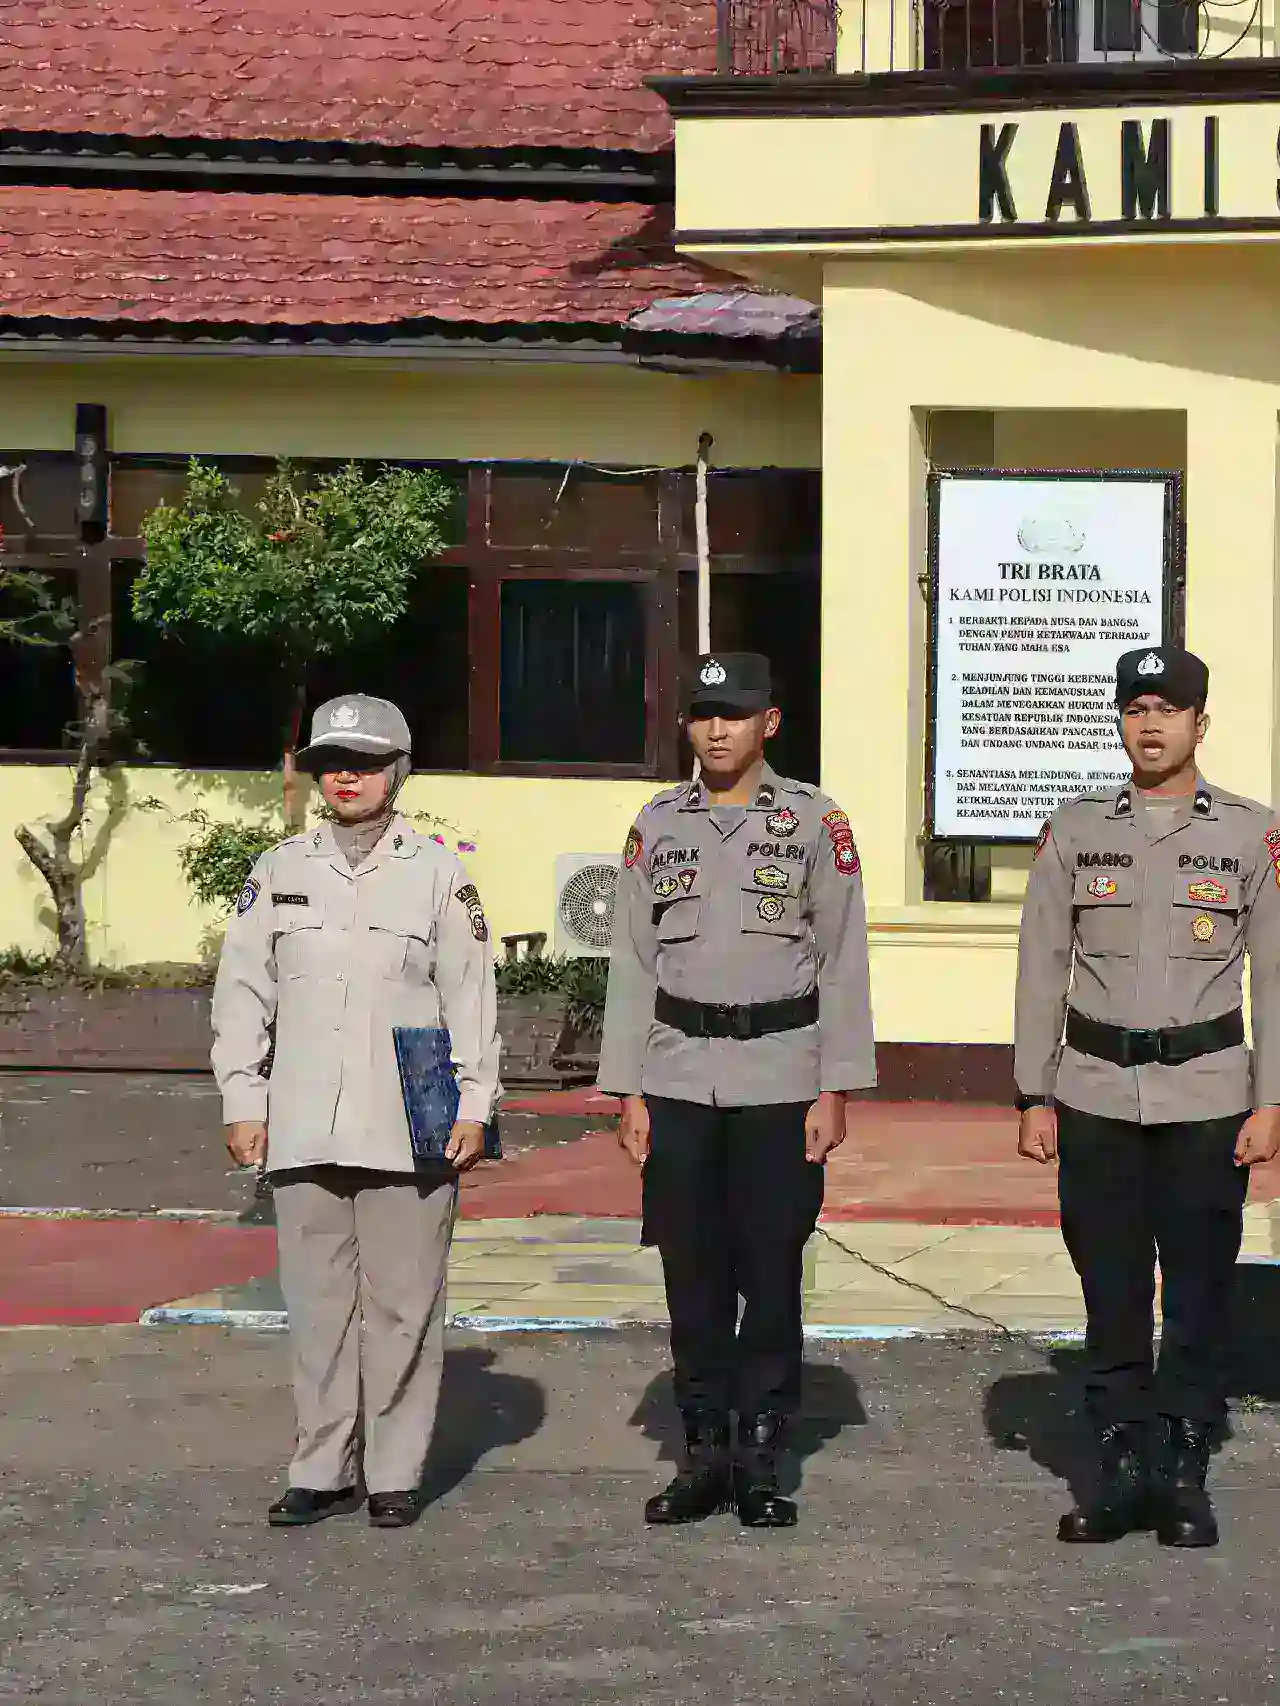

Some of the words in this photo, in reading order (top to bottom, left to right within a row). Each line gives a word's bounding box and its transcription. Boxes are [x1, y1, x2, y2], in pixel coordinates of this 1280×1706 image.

[978, 115, 1219, 224] KAMI
[998, 562, 1031, 580] TRI
[1037, 563, 1102, 582] BRATA
[949, 587, 994, 602] KAMI
[999, 588, 1052, 603] POLISI
[1056, 589, 1152, 604] INDONESIA
[959, 617, 1007, 626] BERBAKTI
[1010, 617, 1048, 626] KEPADA
[1050, 617, 1076, 627] NUSA
[1078, 617, 1098, 627] DAN
[1100, 618, 1139, 628] BANGSA
[958, 629, 998, 639] DENGAN
[1001, 629, 1034, 640] PENUH
[1036, 630, 1096, 641] KETAKWAAN
[958, 642, 991, 652] TUHAN
[994, 643, 1018, 653] YANG
[1021, 643, 1048, 653] MAHA
[1051, 643, 1071, 653] ESA
[961, 673, 1029, 684] MENJUNJUNG
[1031, 673, 1065, 684] TINGGI
[961, 686, 1010, 696] KEADILAN
[1012, 686, 1032, 696] DAN
[1034, 687, 1106, 697] KEMANUSIAAN
[961, 699, 994, 709] DALAM
[996, 699, 1066, 710] MENEGAKKAN
[1067, 700, 1104, 710] HUKUM
[961, 712, 1012, 723] KESATUAN
[1013, 713, 1064, 723] REPUBLIK
[1065, 713, 1119, 724] INDONESIA
[960, 726, 987, 736] YANG
[988, 726, 1060, 737] BERDASARKAN
[1061, 727, 1115, 737] PANCASILA
[960, 739, 980, 749] DAN
[982, 739, 1023, 749] UNDANG
[1024, 740, 1066, 750] UNDANG
[1067, 740, 1100, 751] DASAR
[956, 769, 1017, 780] SENANTIASA
[956, 782, 976, 792] DAN
[978, 783, 1028, 793] MELAYANI
[1029, 784, 1093, 794] MASYARAKAT
[956, 796, 1018, 806] KEIKHLASAN
[1021, 796, 1054, 806] UNTUK
[956, 808, 1010, 819] KEAMANAN
[1012, 809, 1032, 819] DAN
[746, 841, 806, 861] POLRI
[1178, 853, 1240, 874] POLRI
